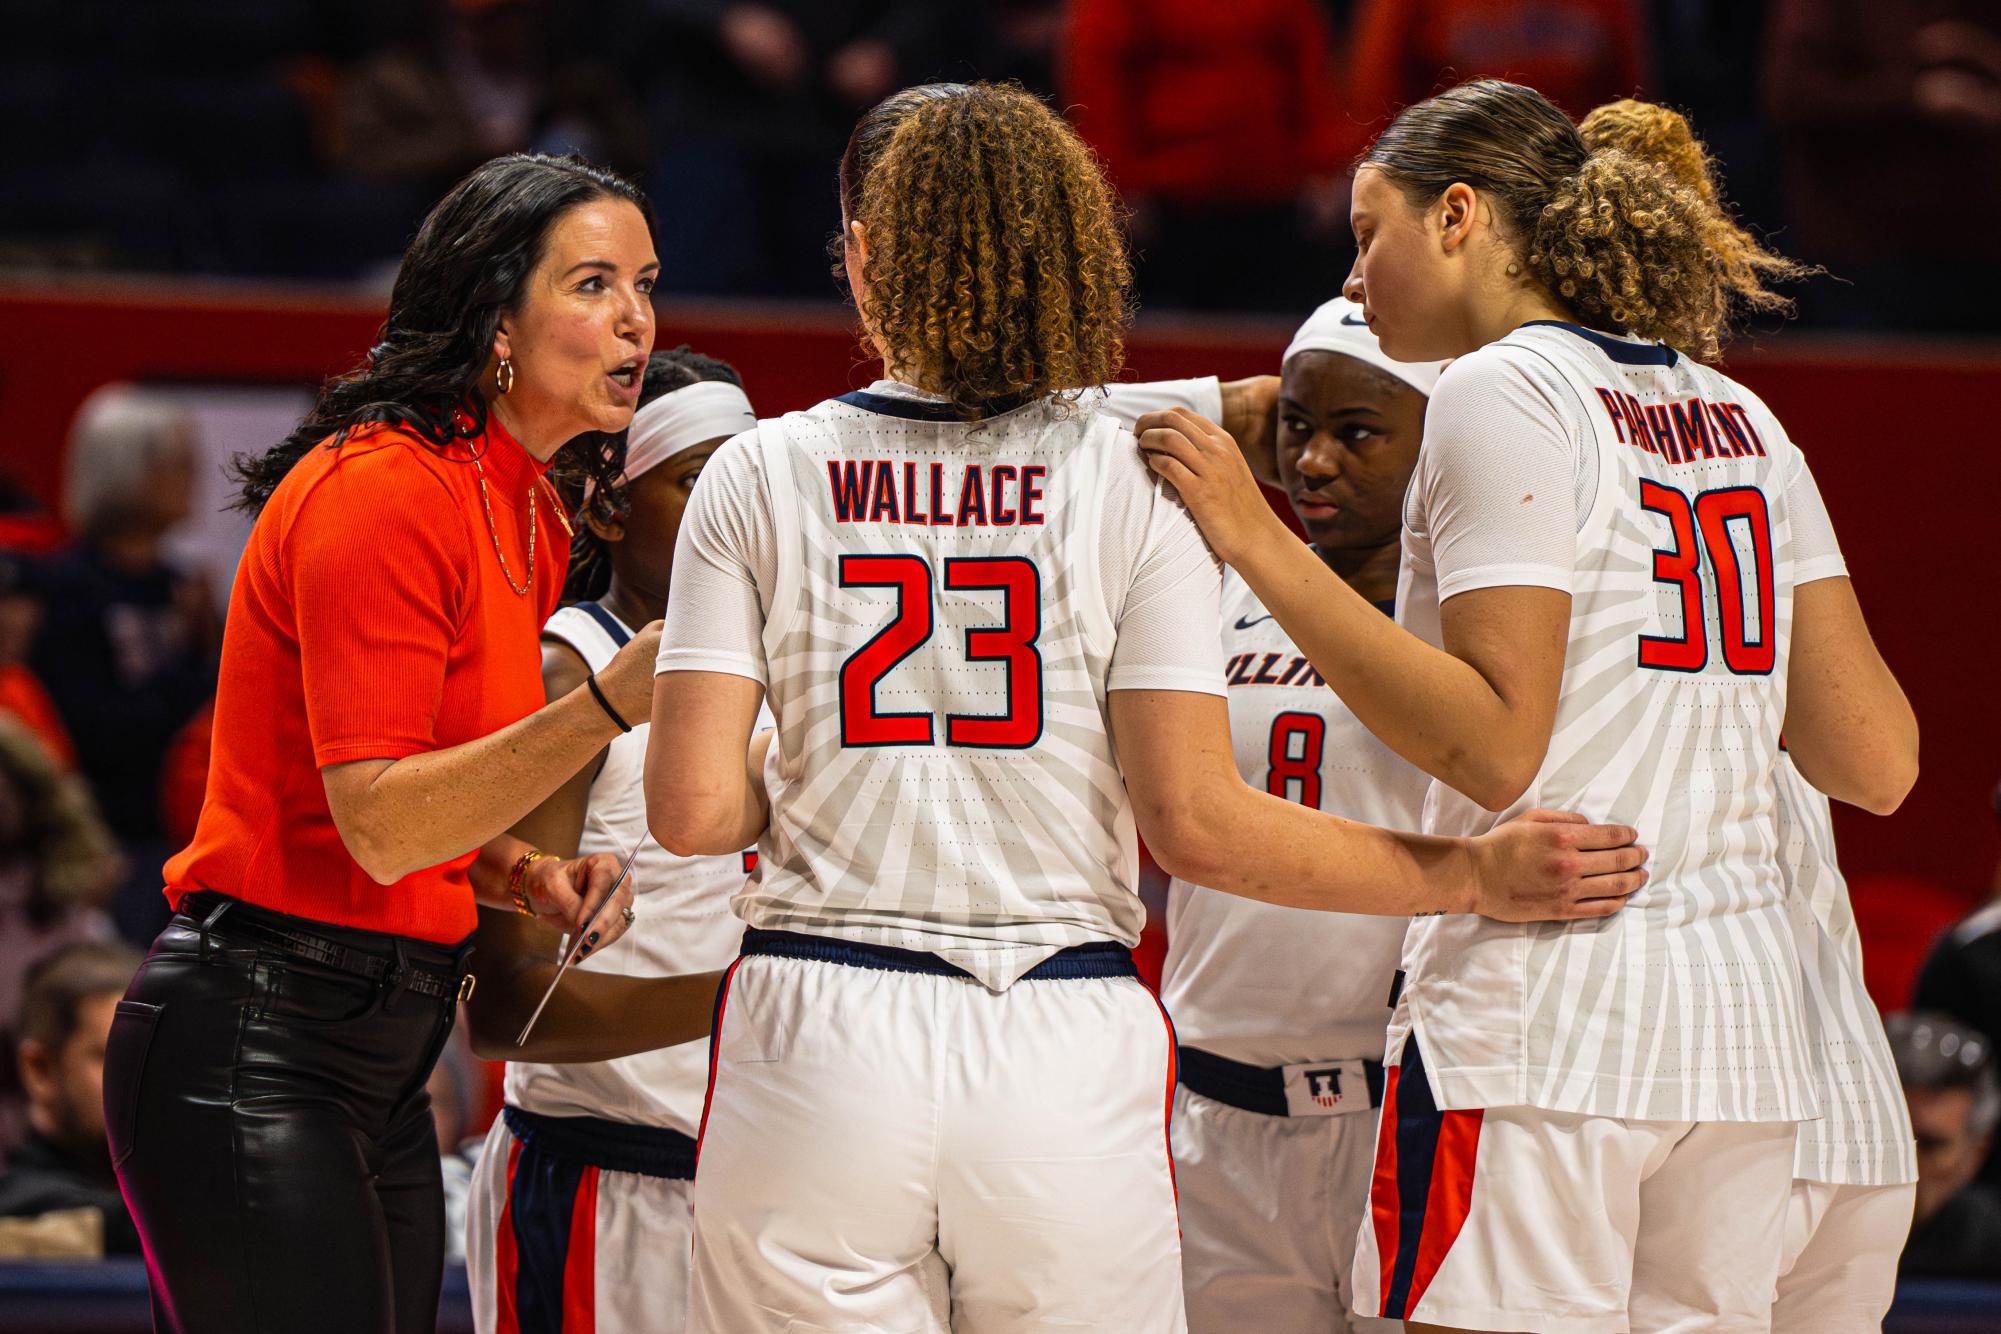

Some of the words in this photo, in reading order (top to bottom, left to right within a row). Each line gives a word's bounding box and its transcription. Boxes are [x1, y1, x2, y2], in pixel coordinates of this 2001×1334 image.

[1594, 387, 1767, 464] PARHMENT
[827, 460, 1046, 527] WALLACE
[1637, 477, 1777, 676] 30
[838, 554, 1043, 750] 23
[1266, 711, 1326, 811] 8
